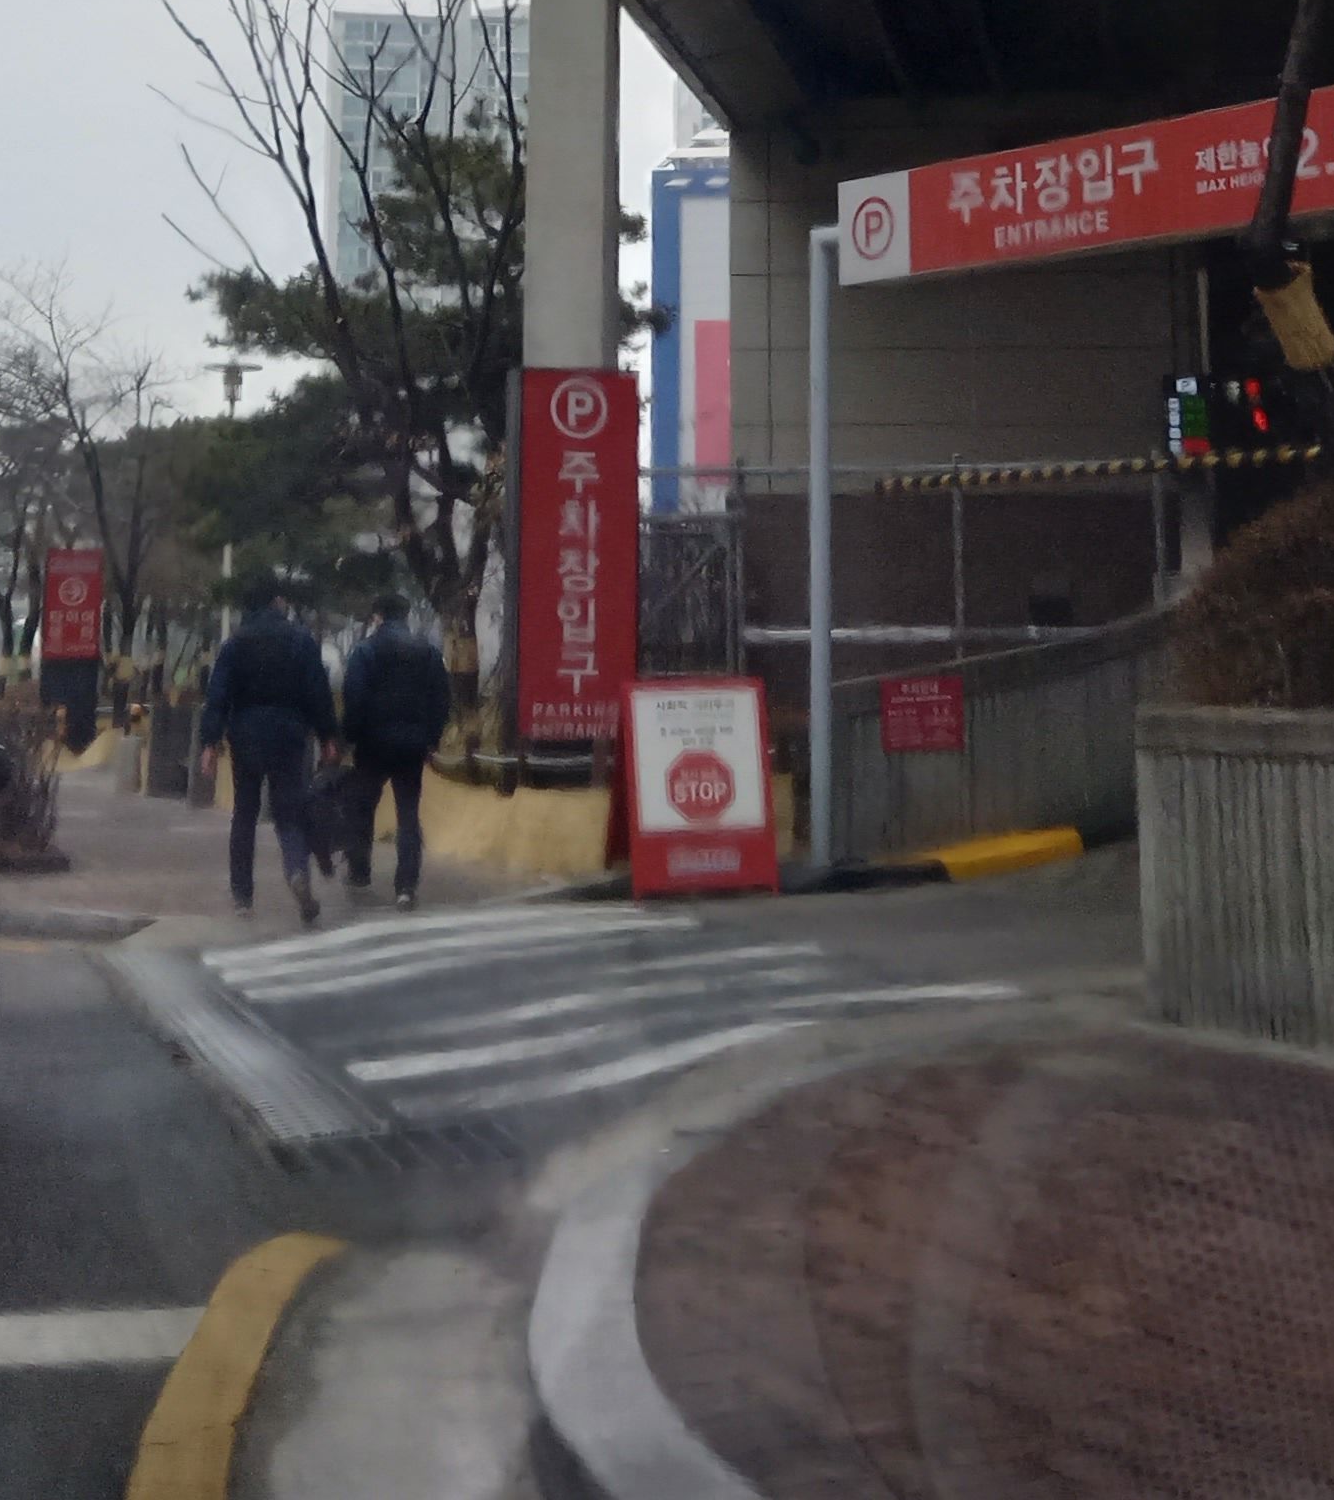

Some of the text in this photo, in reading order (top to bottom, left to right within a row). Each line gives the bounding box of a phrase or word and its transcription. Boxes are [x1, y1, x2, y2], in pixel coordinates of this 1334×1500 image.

[948, 138, 1160, 225] 주차장입구
[1195, 178, 1227, 195] MAX
[994, 209, 1110, 249] ENTRANCE
[556, 450, 601, 697] 주차장입구
[674, 781, 728, 804] STOP
